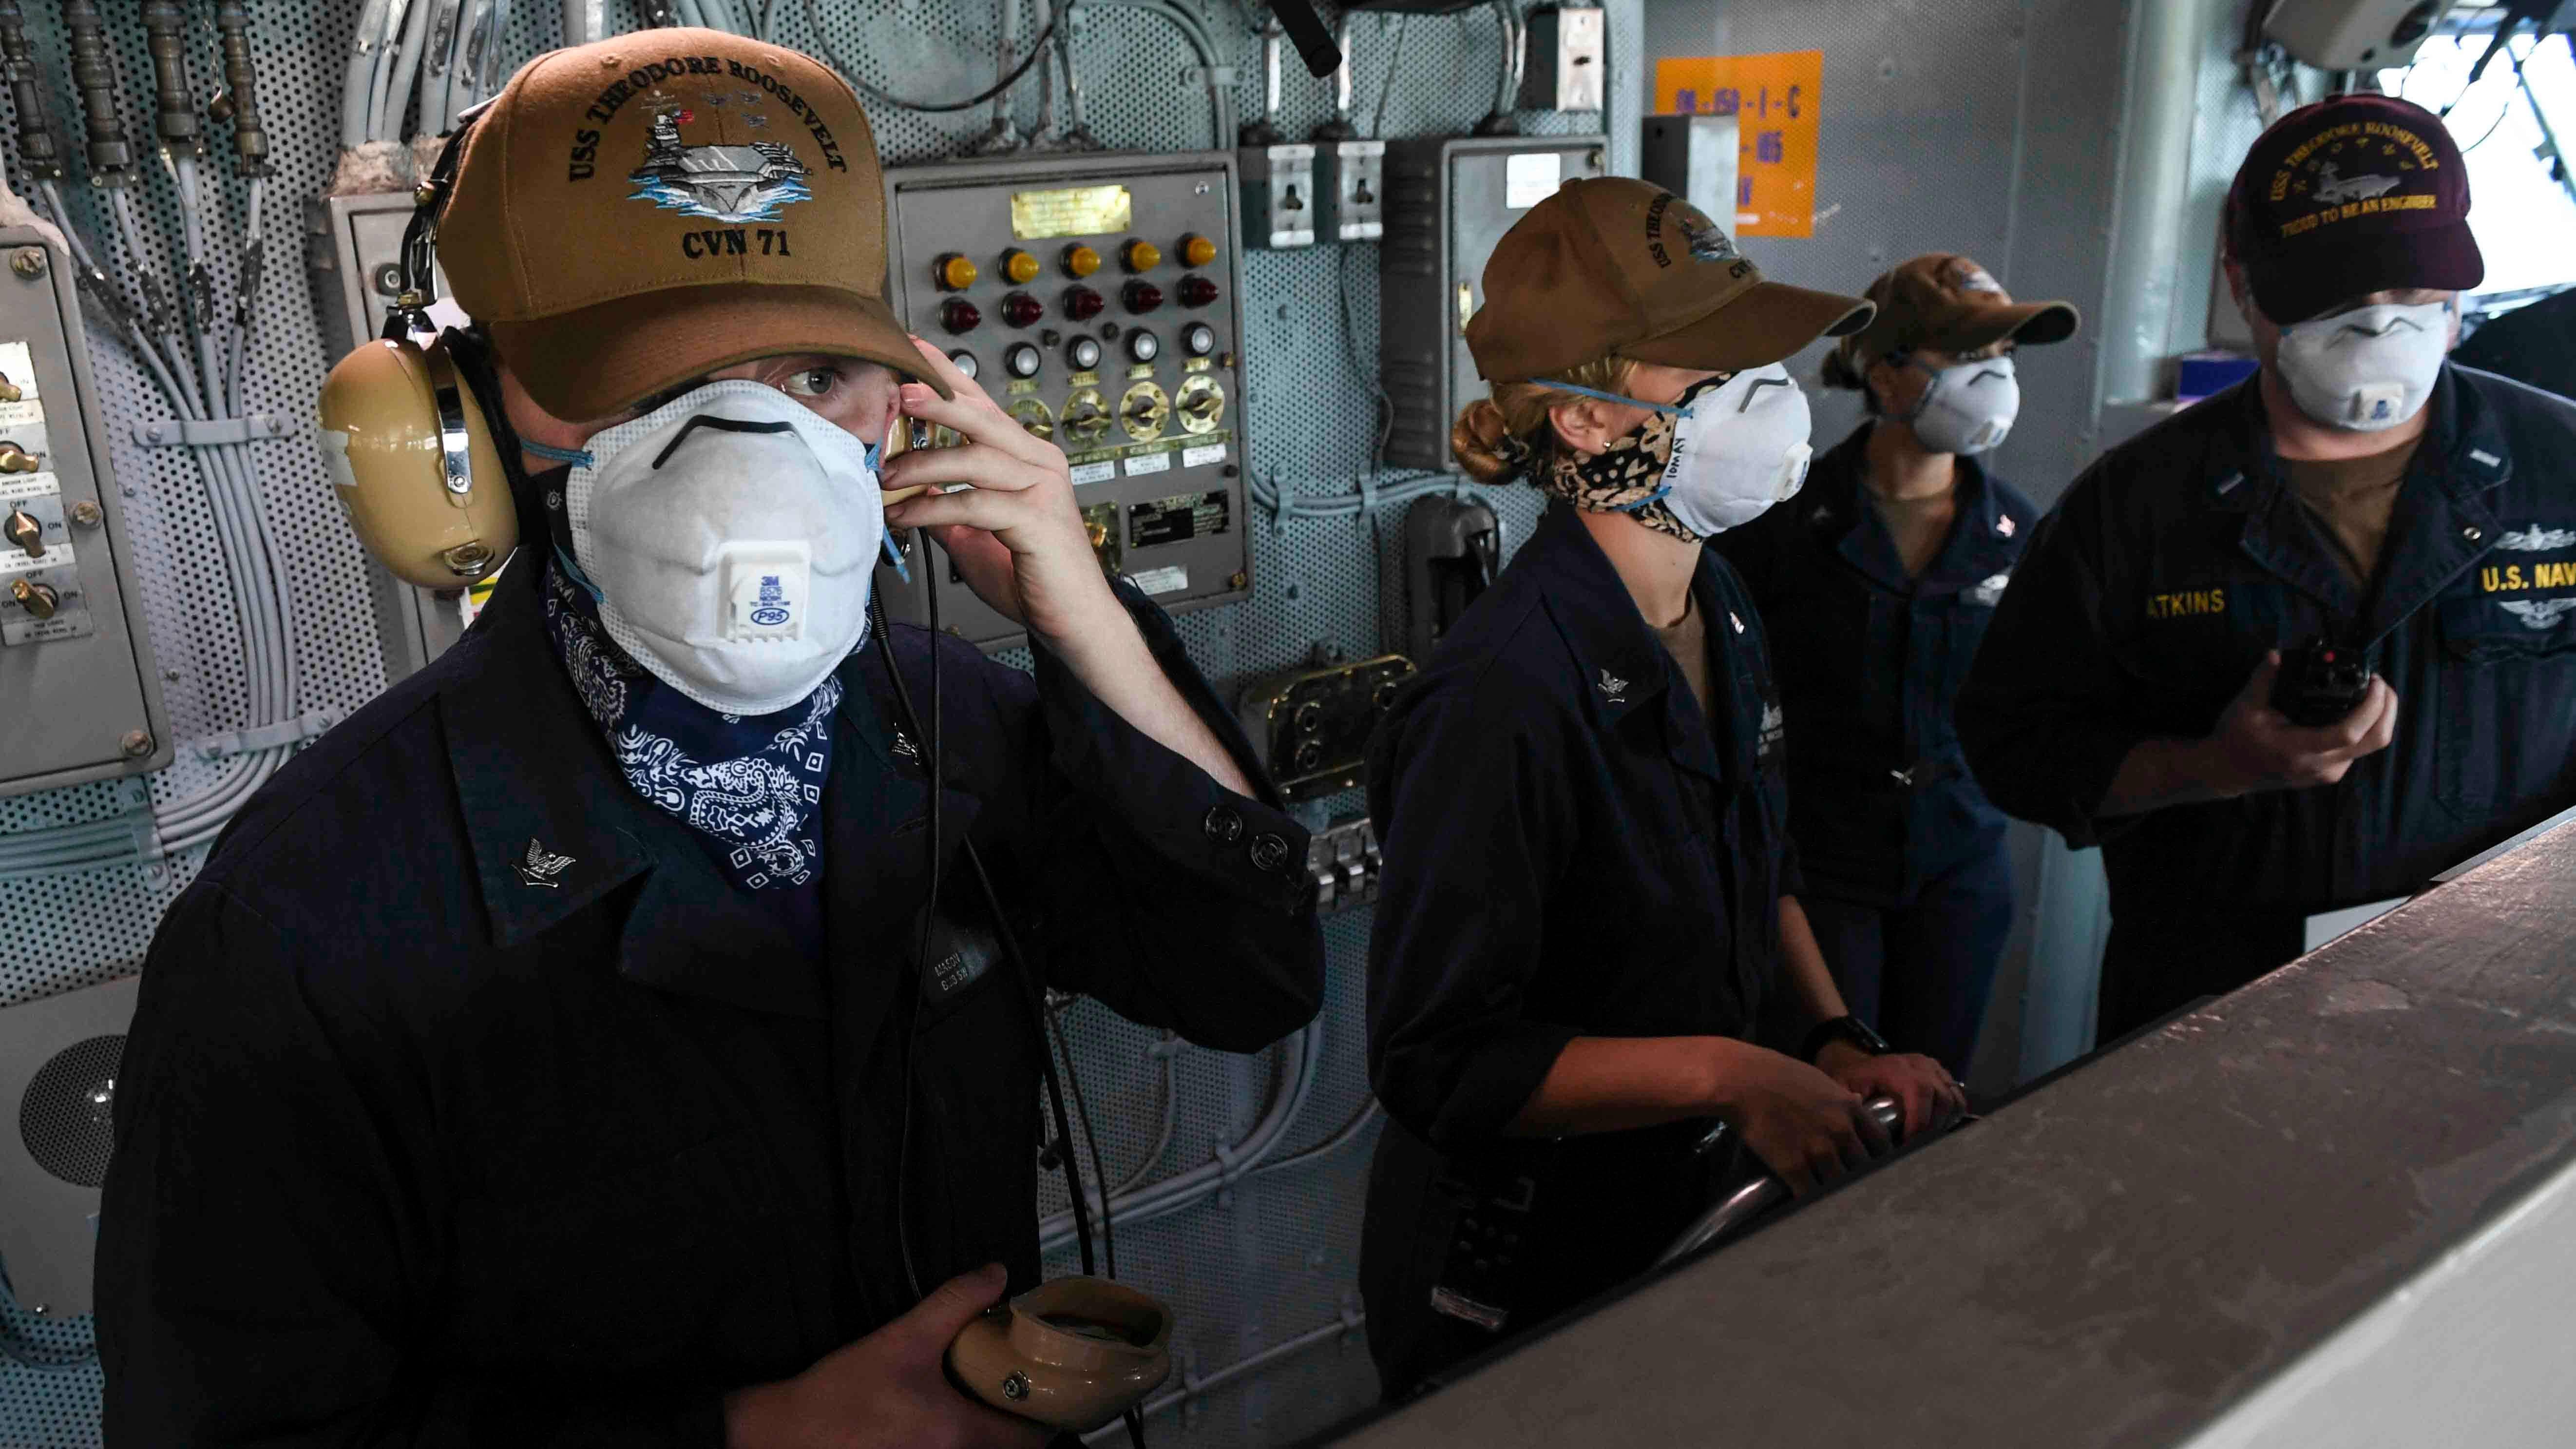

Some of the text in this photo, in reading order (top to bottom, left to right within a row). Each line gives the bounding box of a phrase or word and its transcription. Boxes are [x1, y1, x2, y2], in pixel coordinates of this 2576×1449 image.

[569, 56, 847, 182] USS THEODORE ROOSEVELT
[2320, 206, 2339, 223] TO
[2341, 202, 2359, 219] BE
[2362, 198, 2379, 213] AN
[682, 229, 790, 259] CVN 71
[1649, 242, 1672, 269] USS
[26, 570, 43, 578] OFF
[761, 576, 779, 586] 3M
[2481, 562, 2576, 593] U.S. NAV
[64, 591, 77, 599] ON
[756, 609, 785, 623] P95
